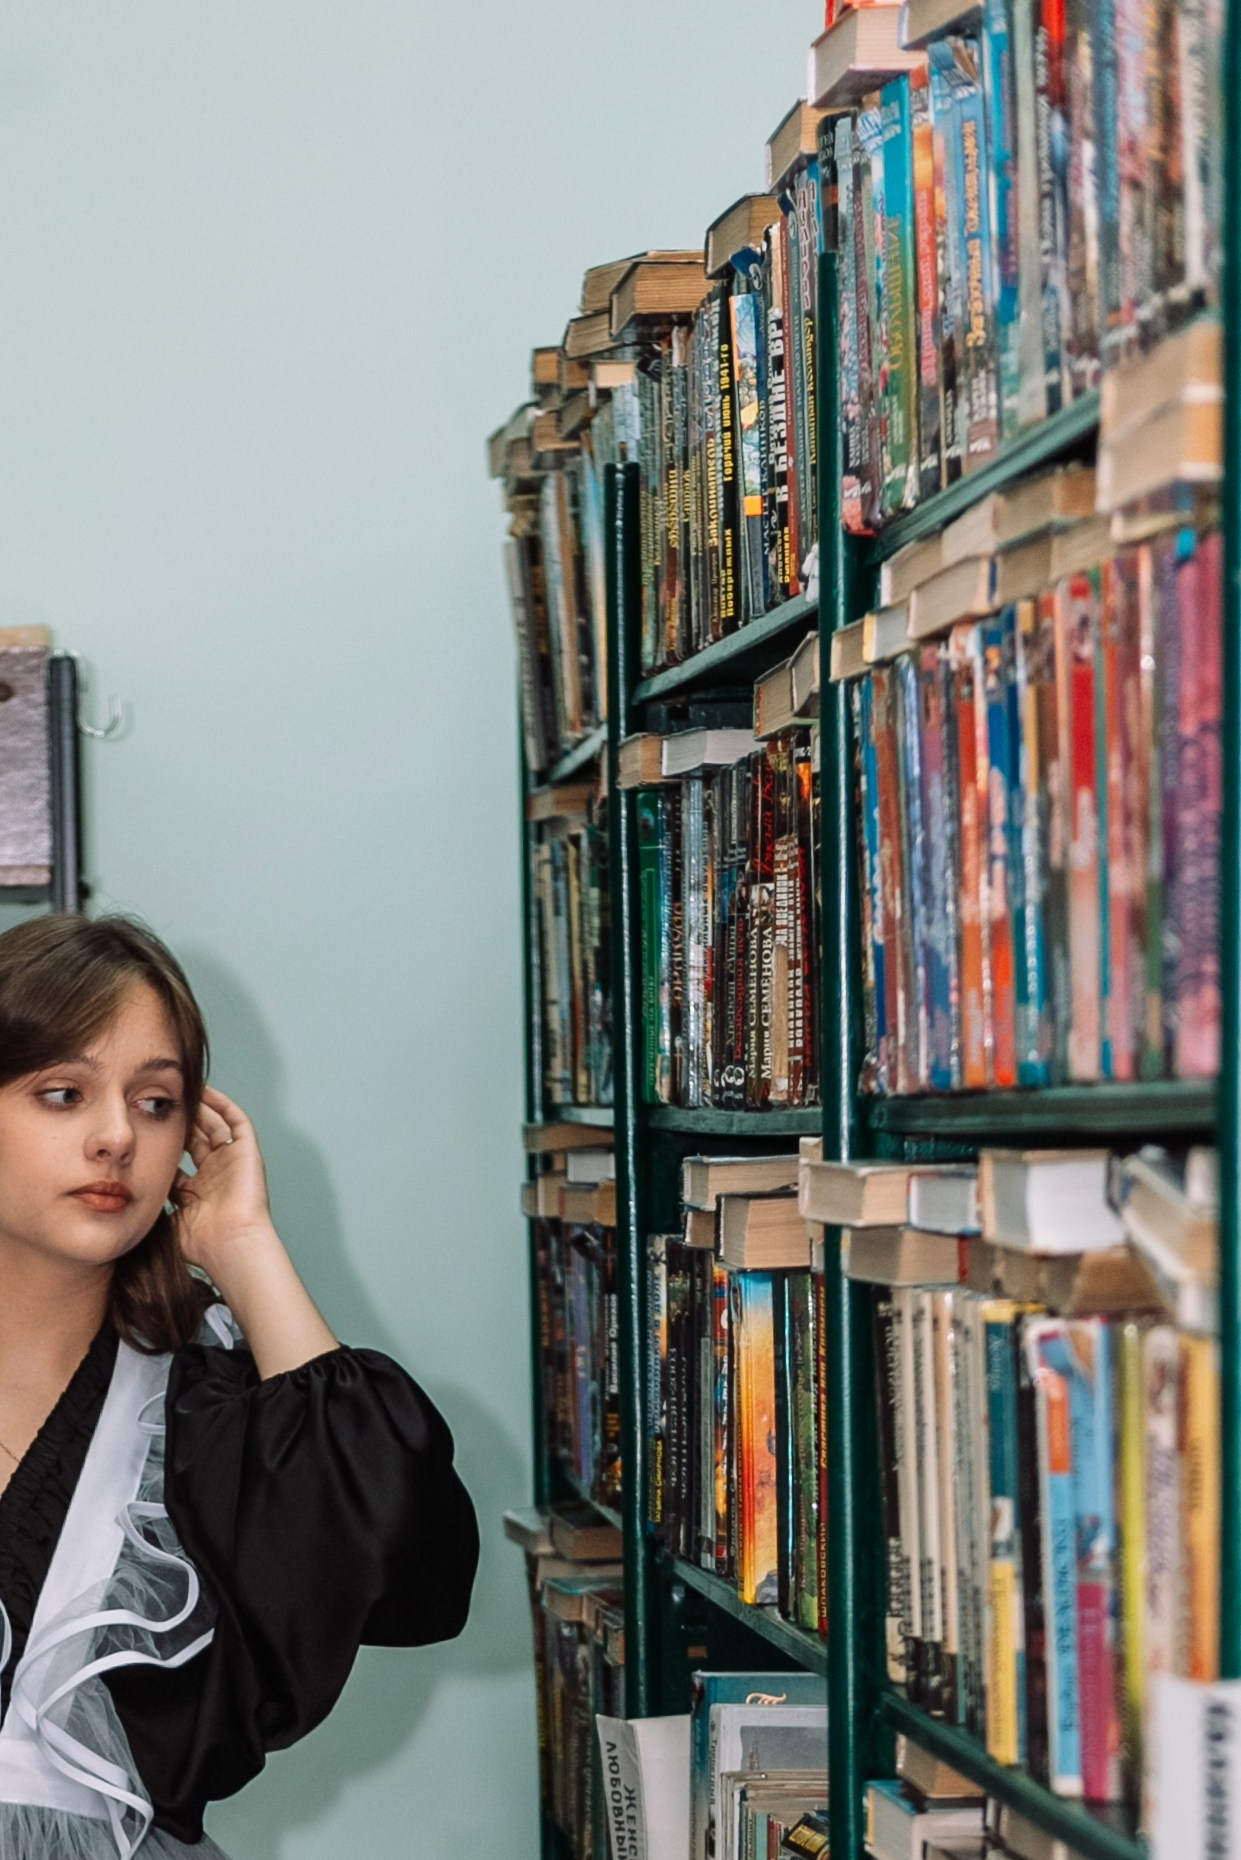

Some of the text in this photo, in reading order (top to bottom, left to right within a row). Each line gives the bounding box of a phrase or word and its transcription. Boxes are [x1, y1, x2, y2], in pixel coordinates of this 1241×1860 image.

[720, 344, 734, 482] Горячий июнь 1941-го
[772, 369, 787, 472] БЕЗДНЕ
[706, 438, 718, 547] Заклинатель
[760, 926, 773, 1079] Мария СЕМЁНОВА
[609, 1293, 619, 1338] Орехов
[818, 1521, 828, 1618] ШПАКОВСКИЙ
